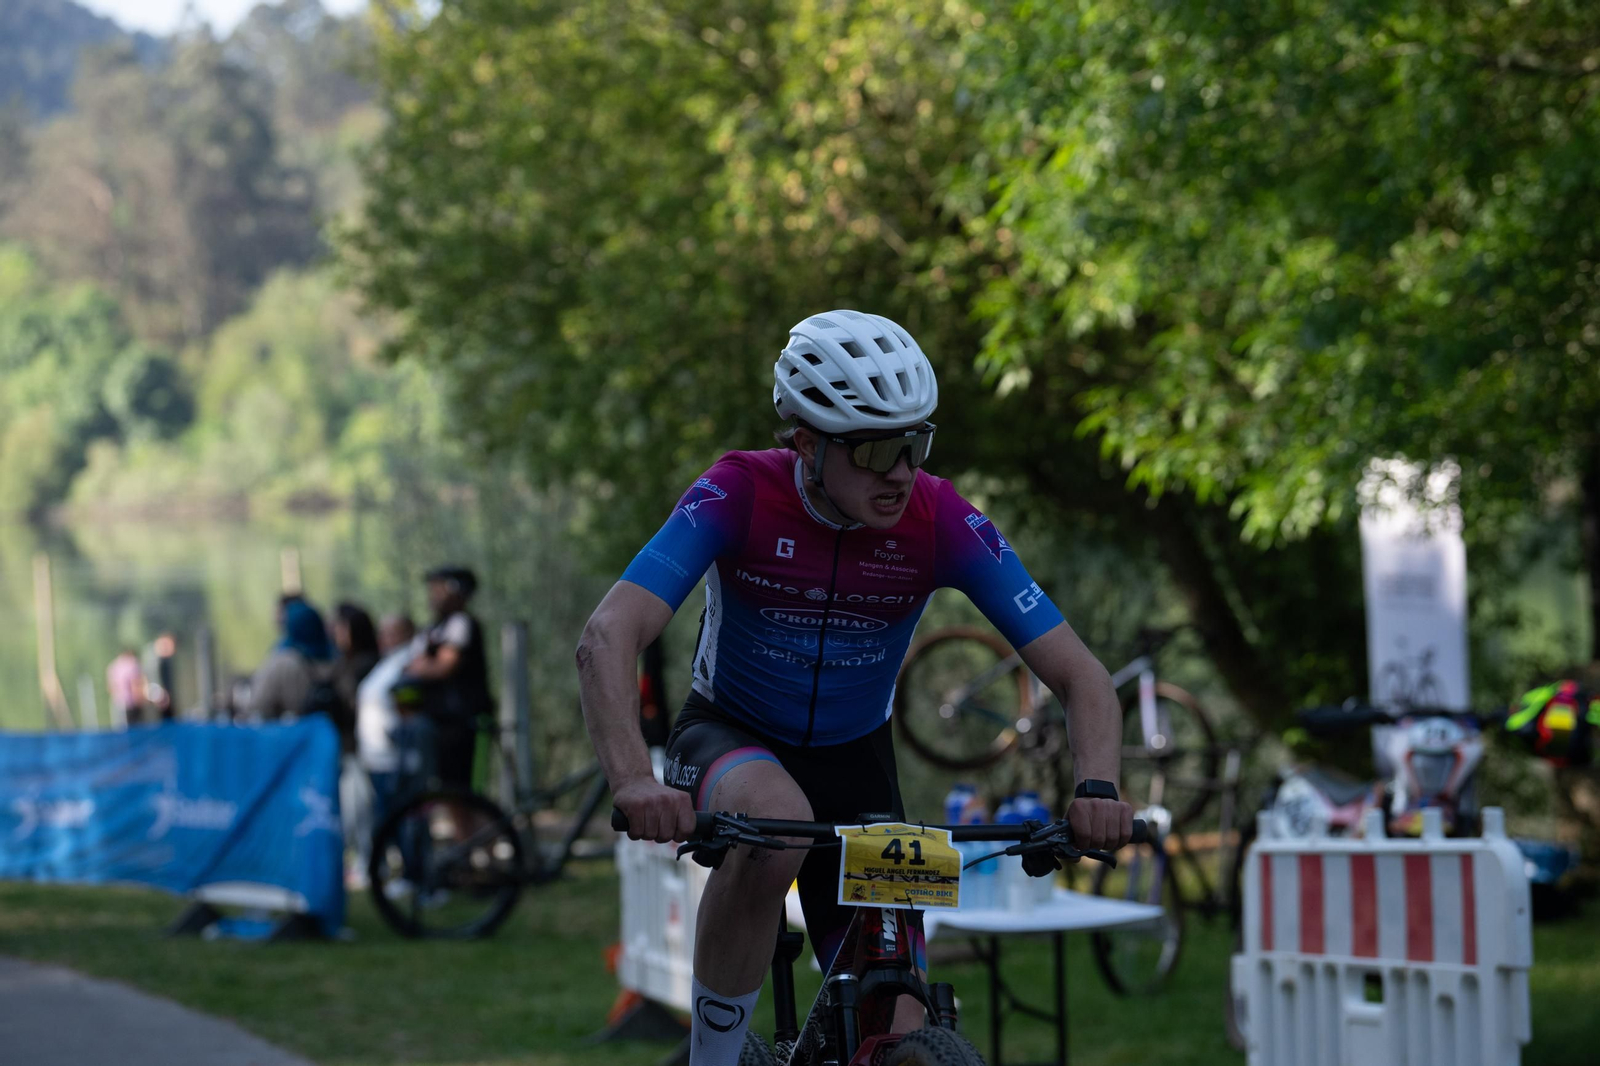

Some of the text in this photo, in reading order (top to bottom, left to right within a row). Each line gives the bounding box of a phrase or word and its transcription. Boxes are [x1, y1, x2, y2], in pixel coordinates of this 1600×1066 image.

[873, 548, 906, 561] Foyer
[858, 561, 884, 569] Mangen
[890, 565, 919, 574] Associés
[734, 568, 800, 595] IMMO
[832, 594, 915, 604] LOSCH
[773, 611, 877, 630] PROPHAC
[880, 838, 926, 866] 41
[906, 868, 940, 876] FERNANDEZ
[905, 888, 953, 898] COTIÑO BIKE
